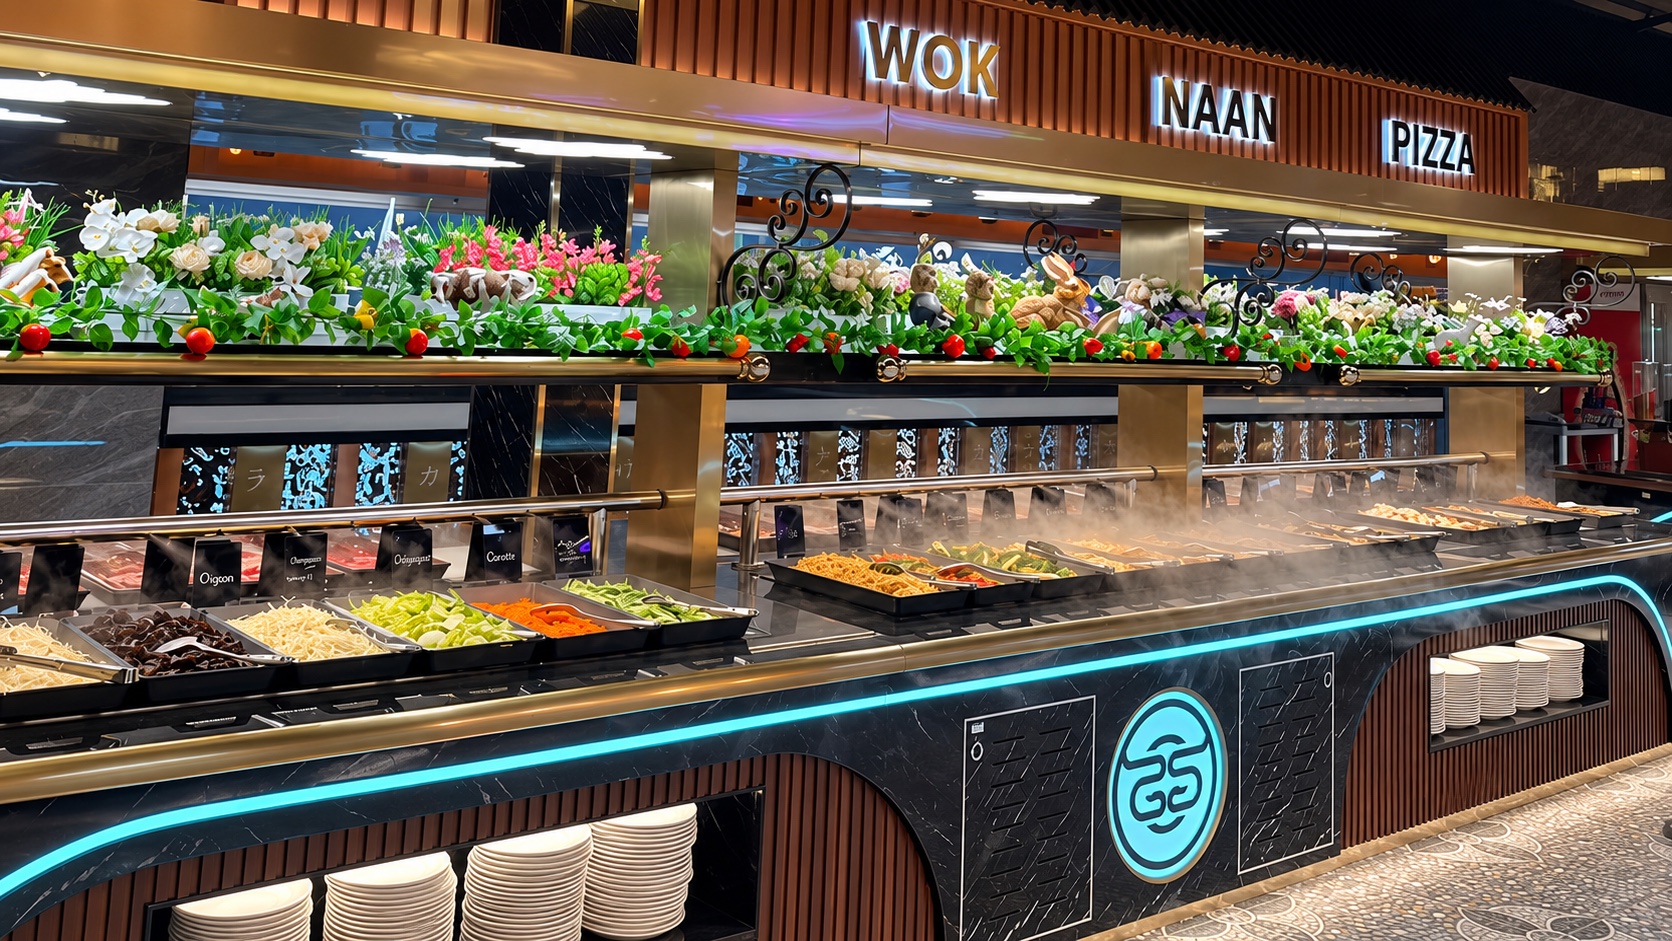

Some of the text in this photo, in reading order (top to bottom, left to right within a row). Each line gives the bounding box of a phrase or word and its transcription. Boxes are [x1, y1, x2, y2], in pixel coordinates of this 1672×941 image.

[866, 21, 1000, 98] WOK
[1161, 76, 1276, 142] NAAN
[1390, 119, 1475, 175] PIZZA
